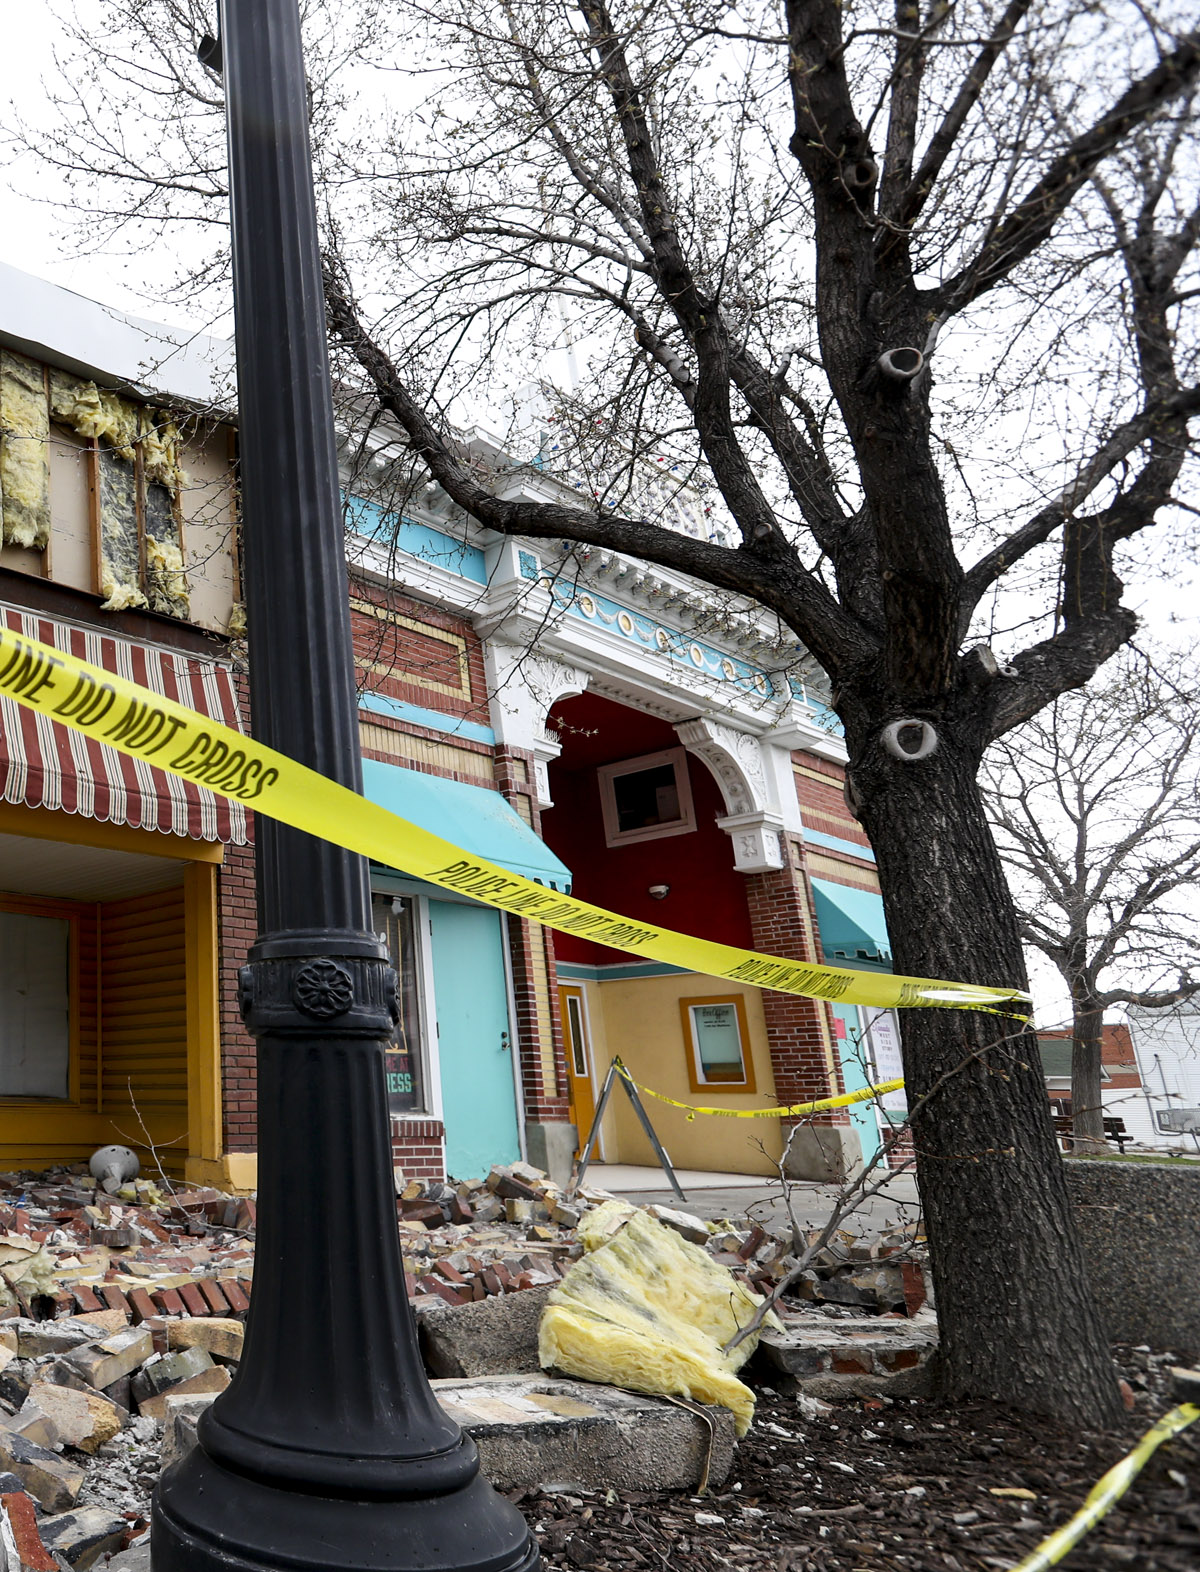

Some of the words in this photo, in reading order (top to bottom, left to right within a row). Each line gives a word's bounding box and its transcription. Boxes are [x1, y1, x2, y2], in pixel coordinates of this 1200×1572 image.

[52, 670, 116, 727] DO
[103, 697, 187, 756] NOT
[169, 732, 280, 800] CROSS
[424, 860, 520, 899] POLICE
[489, 888, 559, 912] LINE
[530, 903, 581, 925] DO
[563, 913, 614, 936] NOT
[587, 922, 659, 947] CROSS
